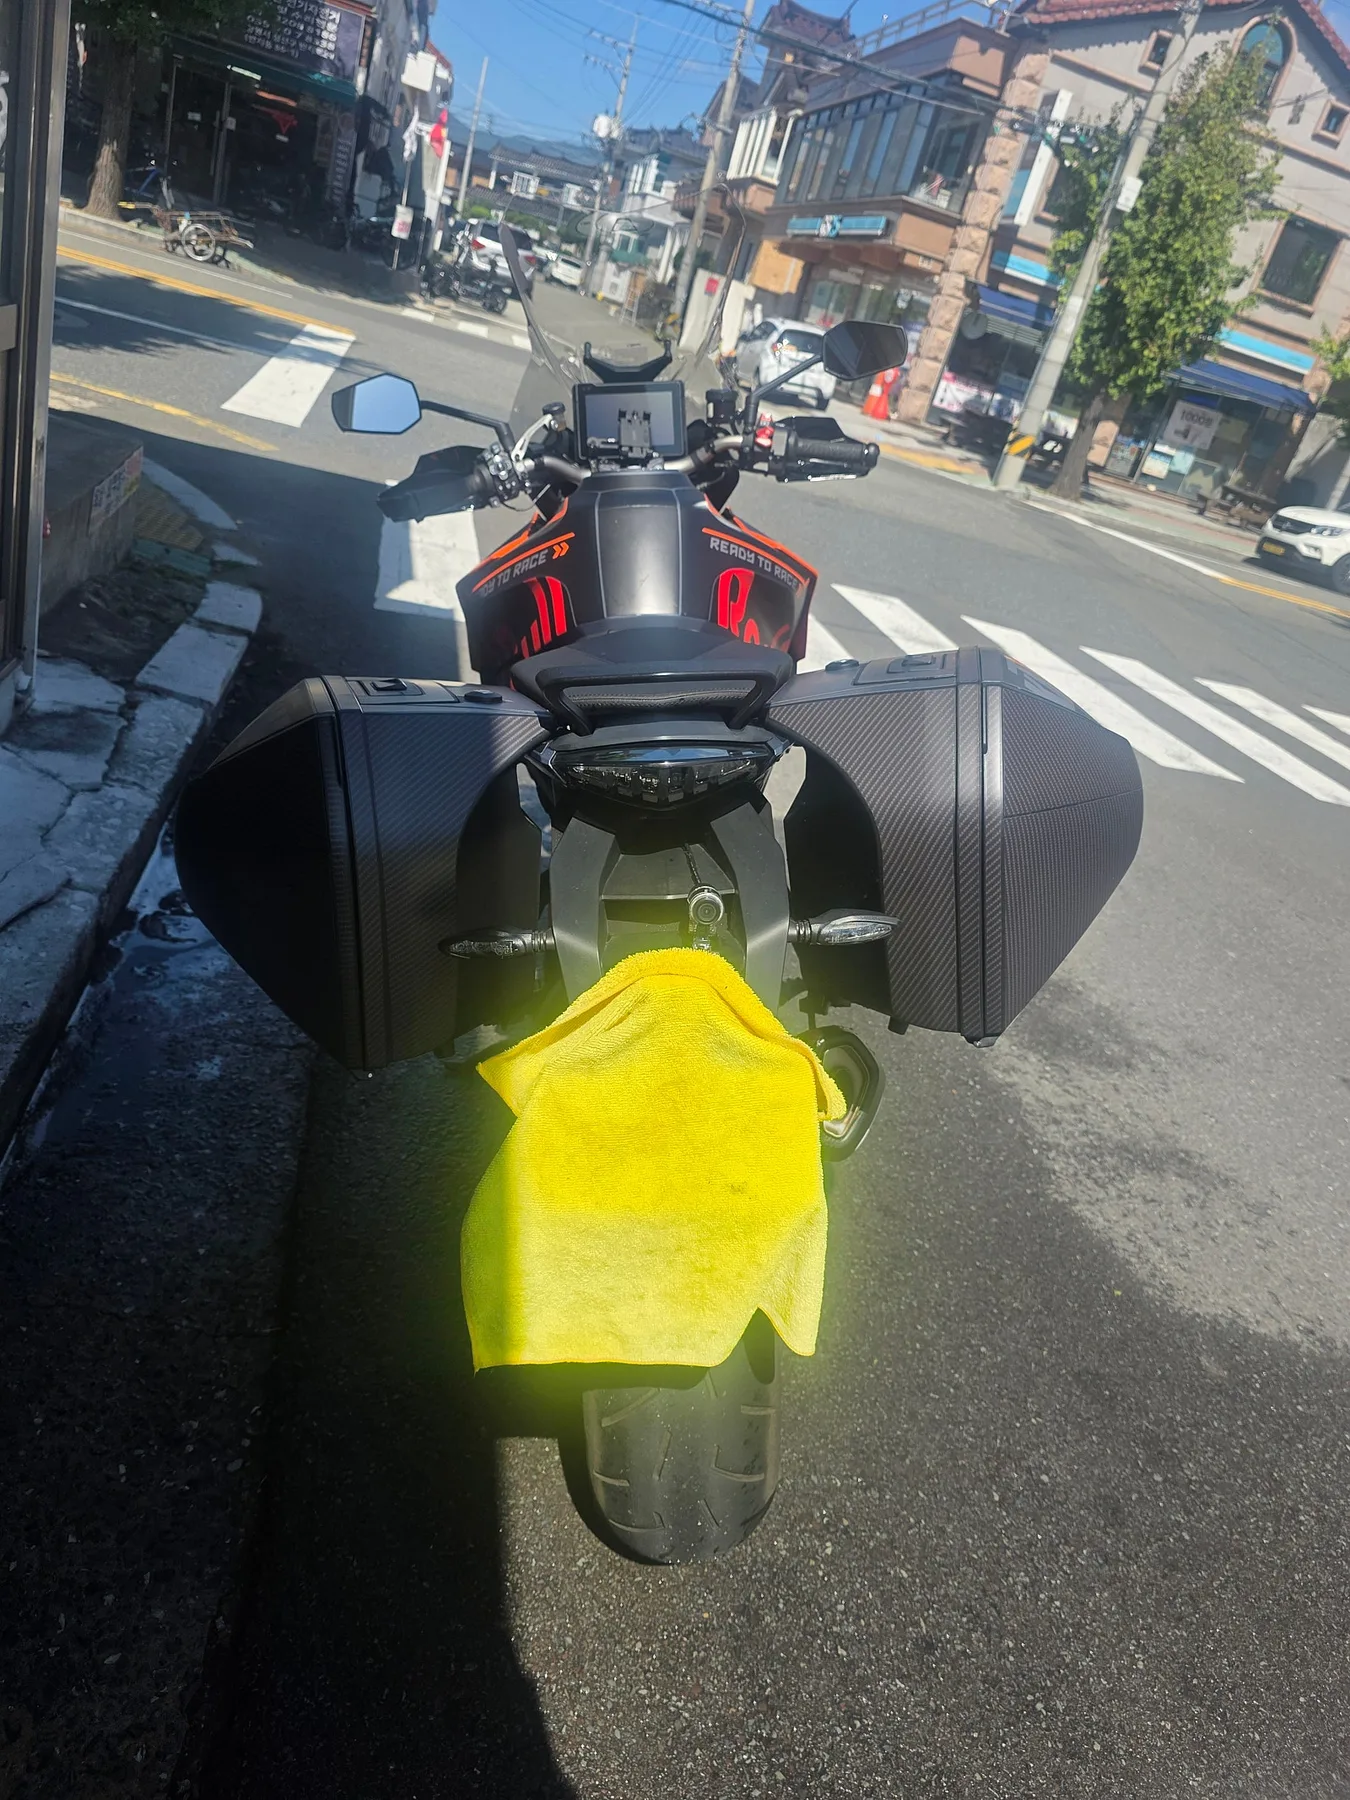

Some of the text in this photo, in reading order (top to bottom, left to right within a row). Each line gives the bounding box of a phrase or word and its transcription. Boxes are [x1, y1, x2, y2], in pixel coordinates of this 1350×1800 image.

[497, 549, 549, 588] TO RACE
[709, 537, 799, 589] READY TO RACE
